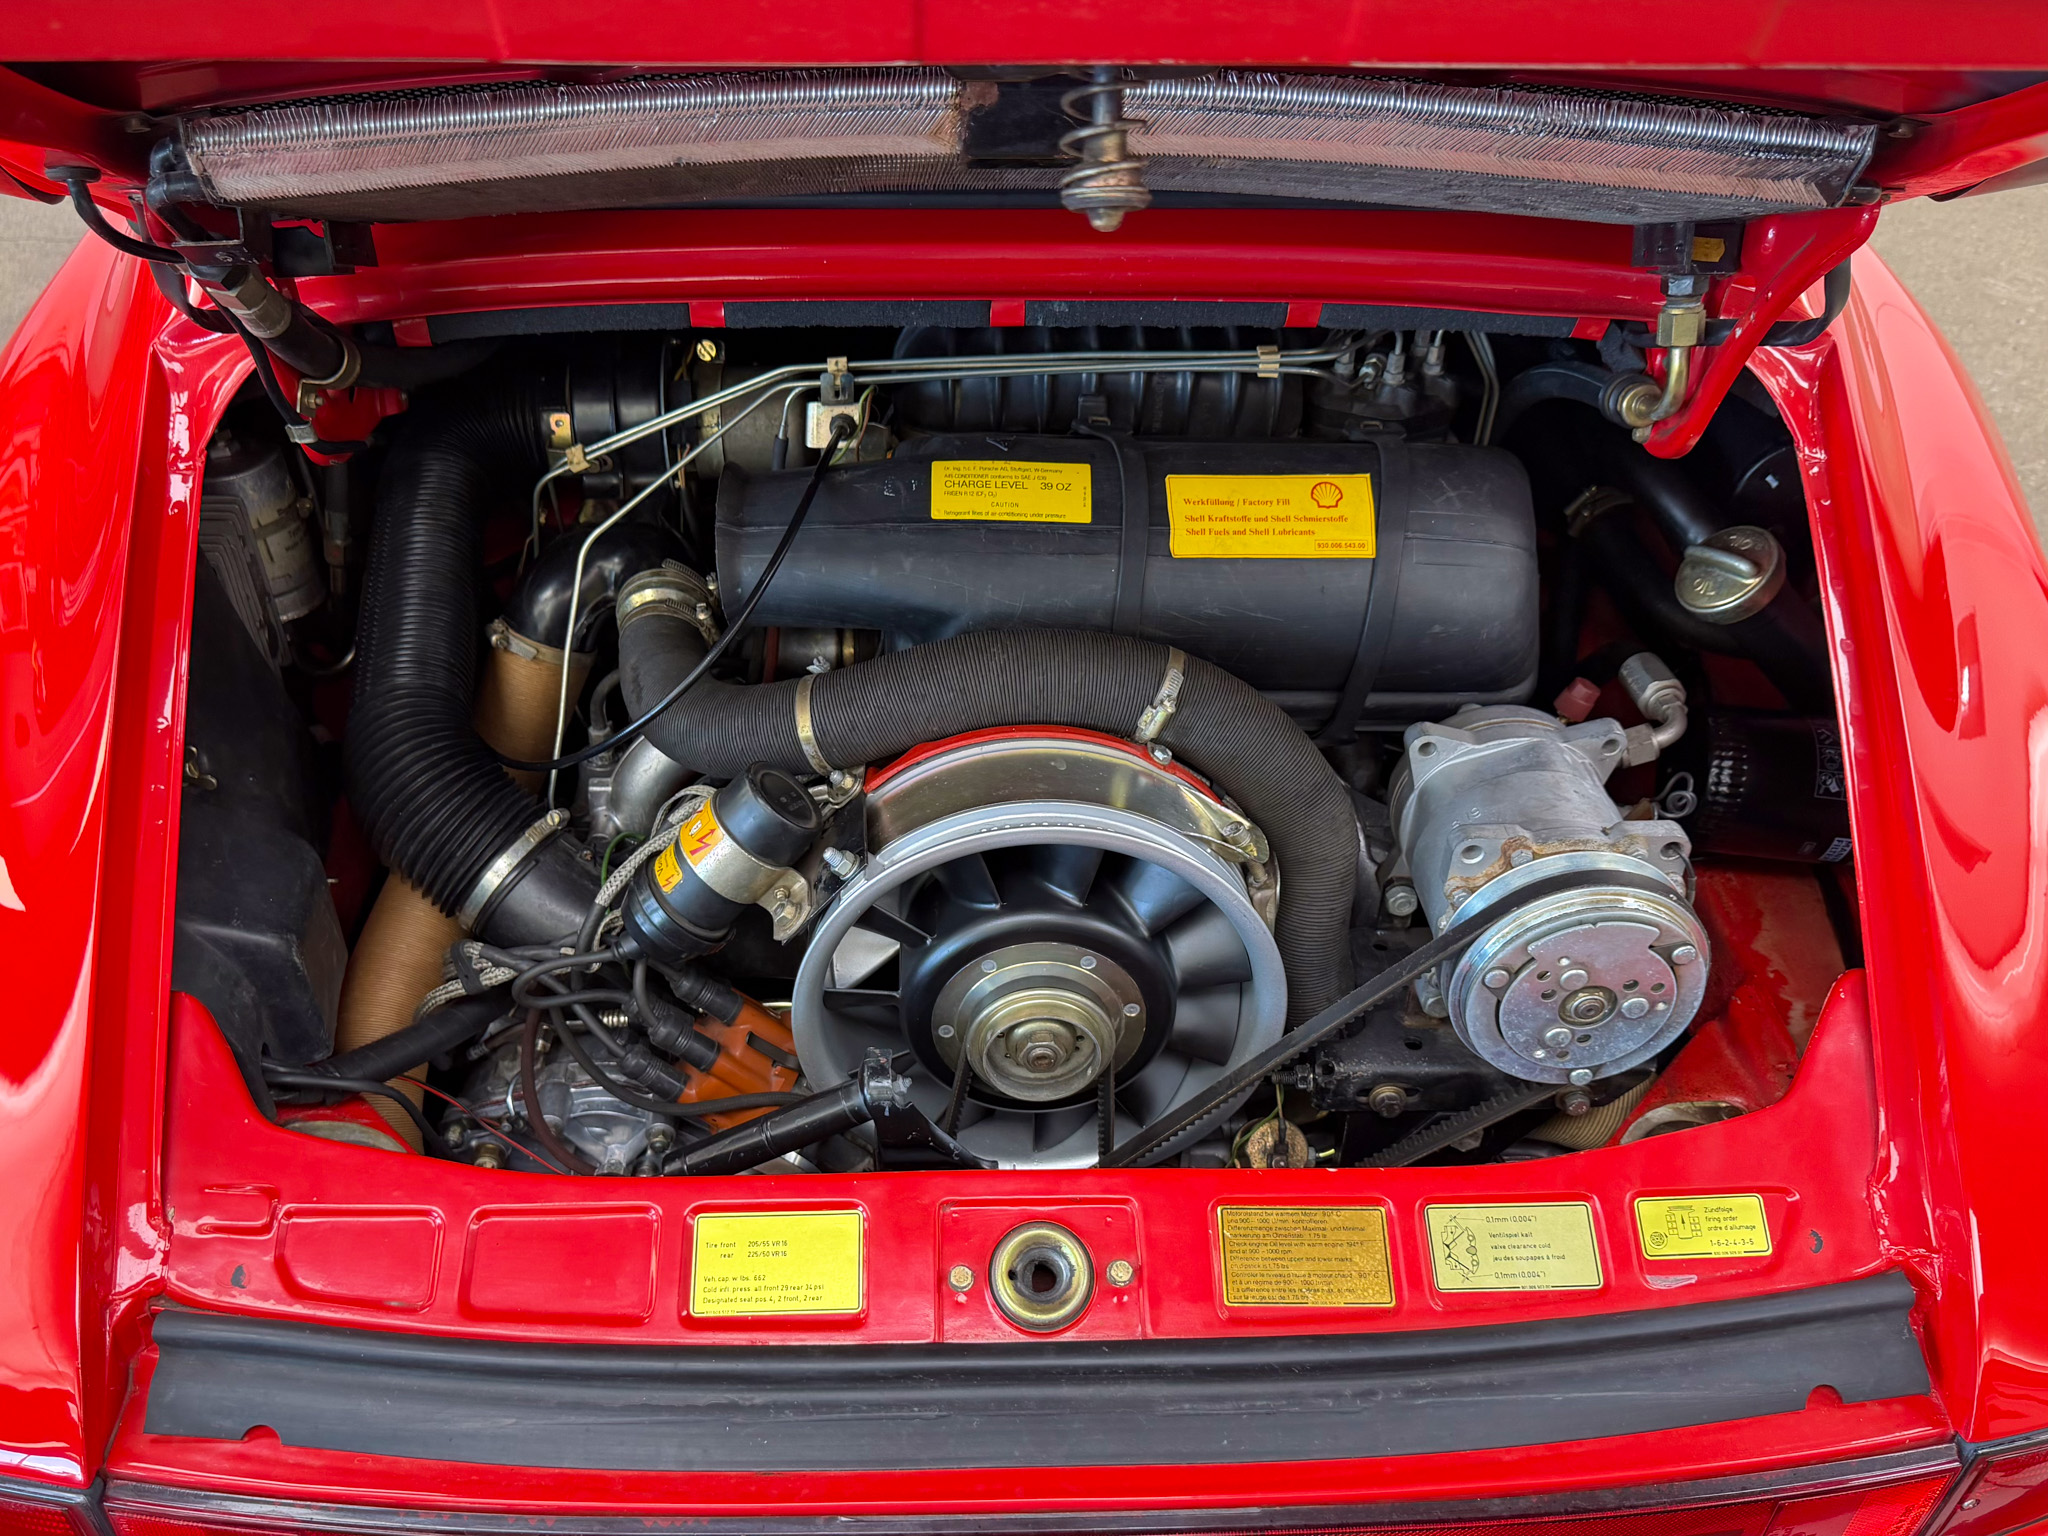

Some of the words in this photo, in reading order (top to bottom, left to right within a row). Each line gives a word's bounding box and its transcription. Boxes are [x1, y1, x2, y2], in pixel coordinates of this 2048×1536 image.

[944, 480, 992, 489] CHARGE
[994, 480, 1028, 490] LEVEL
[1040, 482, 1053, 491] 39
[1055, 482, 1072, 492] OZ
[1184, 498, 1235, 507] Werkfüllung
[1242, 498, 1274, 507] Factory
[1276, 498, 1290, 506] Fill
[1184, 514, 1205, 523] Shell
[1208, 515, 1252, 523] Kraftstoffe
[1254, 515, 1268, 523] und
[1271, 515, 1291, 523] Shell
[1294, 515, 1349, 523] Schmierstoffe
[1185, 528, 1206, 536] Shell
[1208, 528, 1230, 536] Fuels
[1232, 528, 1247, 536] and
[1250, 528, 1270, 536] Shell
[1272, 528, 1315, 536] Lubricants
[747, 1240, 770, 1248] 205/55
[1710, 1238, 1754, 1247] 1-6-2-4-3-5
[813, 1284, 824, 1292] psi
[703, 1295, 738, 1304] Designated
[739, 1295, 753, 1303] seat
